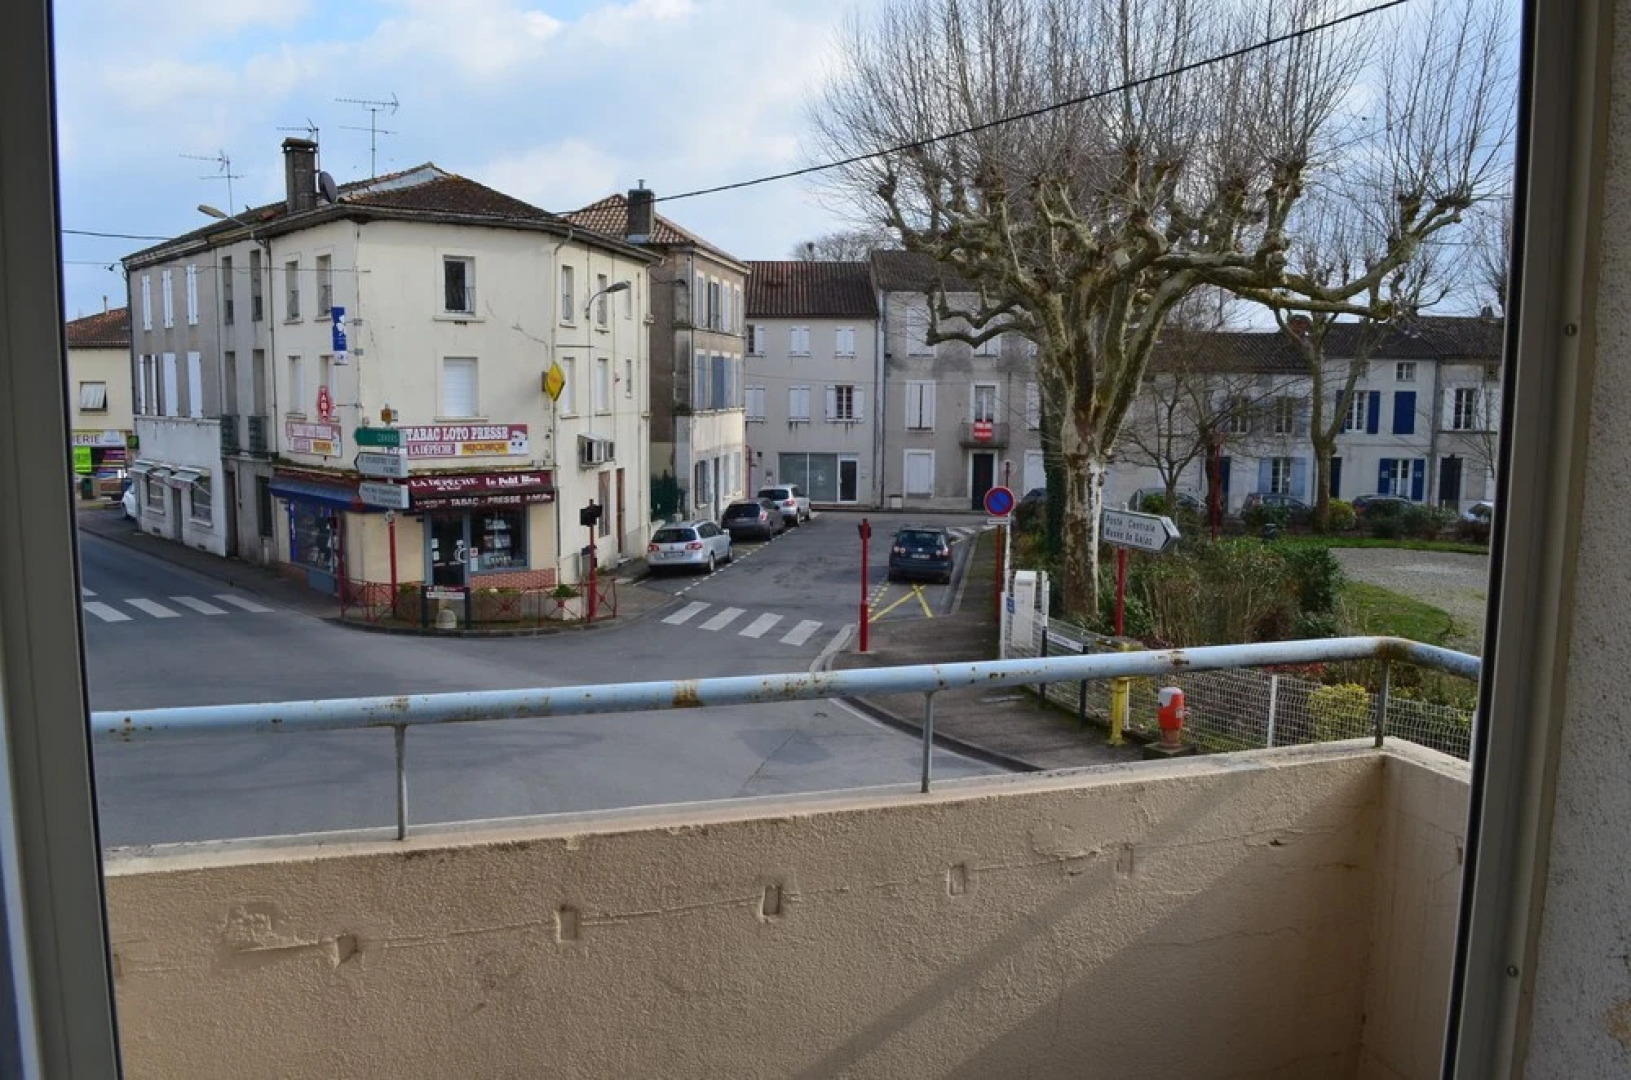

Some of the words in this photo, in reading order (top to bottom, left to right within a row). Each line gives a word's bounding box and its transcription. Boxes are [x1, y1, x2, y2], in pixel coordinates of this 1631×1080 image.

[406, 427, 441, 442] TABAC
[442, 426, 469, 441] LOTO
[471, 426, 509, 440] PRESSE
[451, 497, 479, 508] TABAC
[487, 495, 521, 505] PRESSE
